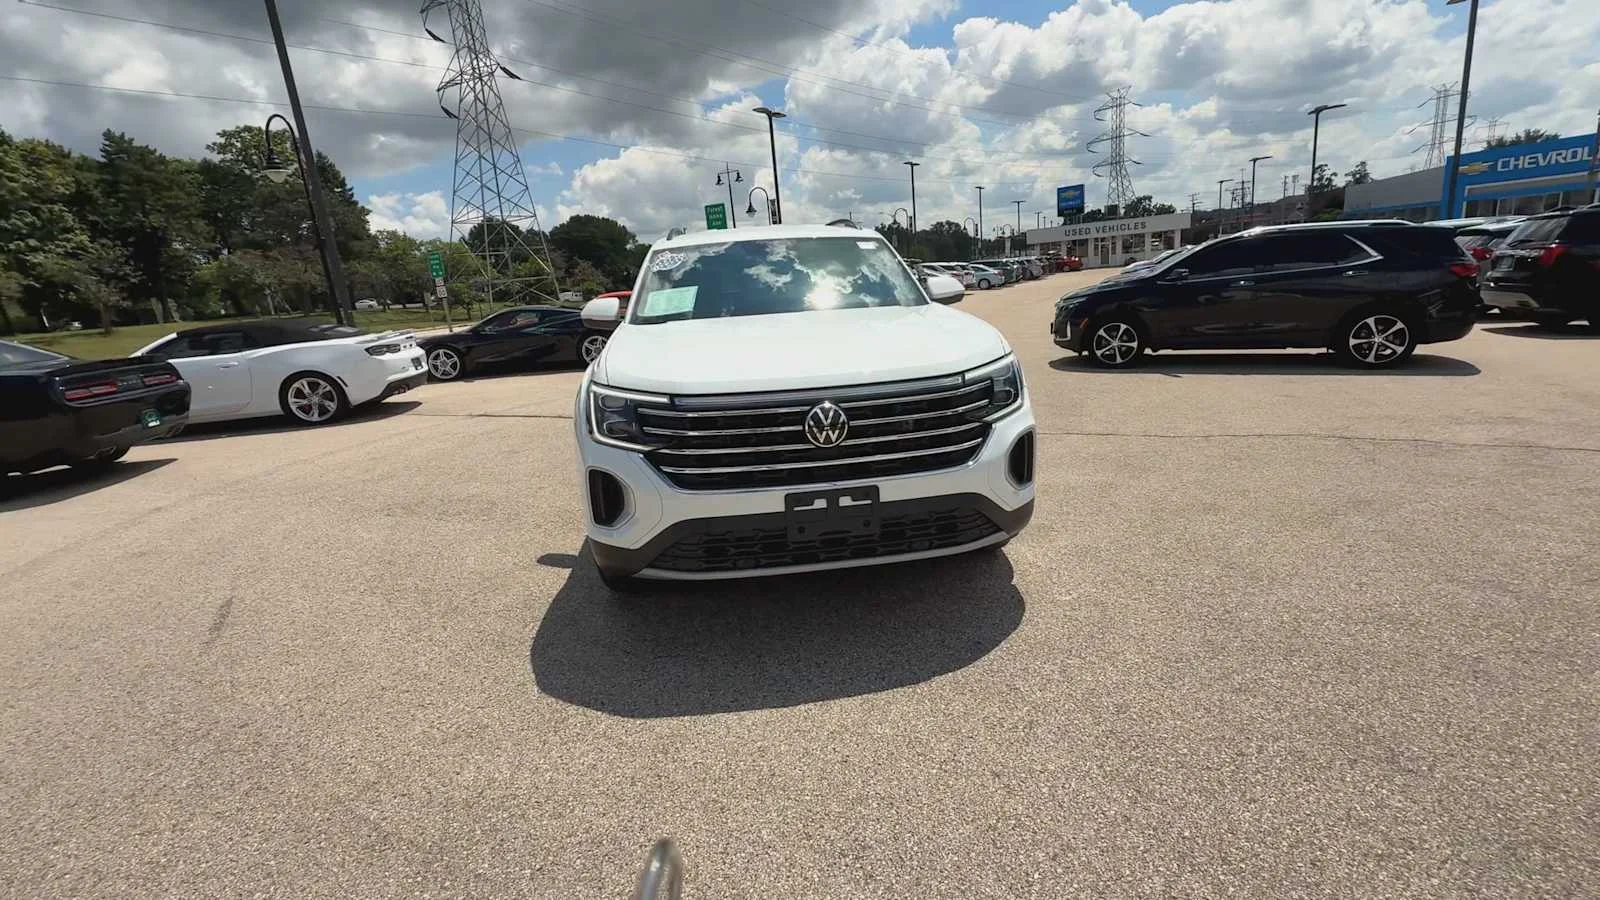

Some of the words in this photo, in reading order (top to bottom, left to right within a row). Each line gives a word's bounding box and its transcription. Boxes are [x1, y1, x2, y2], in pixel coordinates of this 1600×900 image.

[1497, 145, 1600, 172] CHEVROL
[1064, 227, 1091, 237] USED
[1095, 221, 1147, 233] VEHICLES
